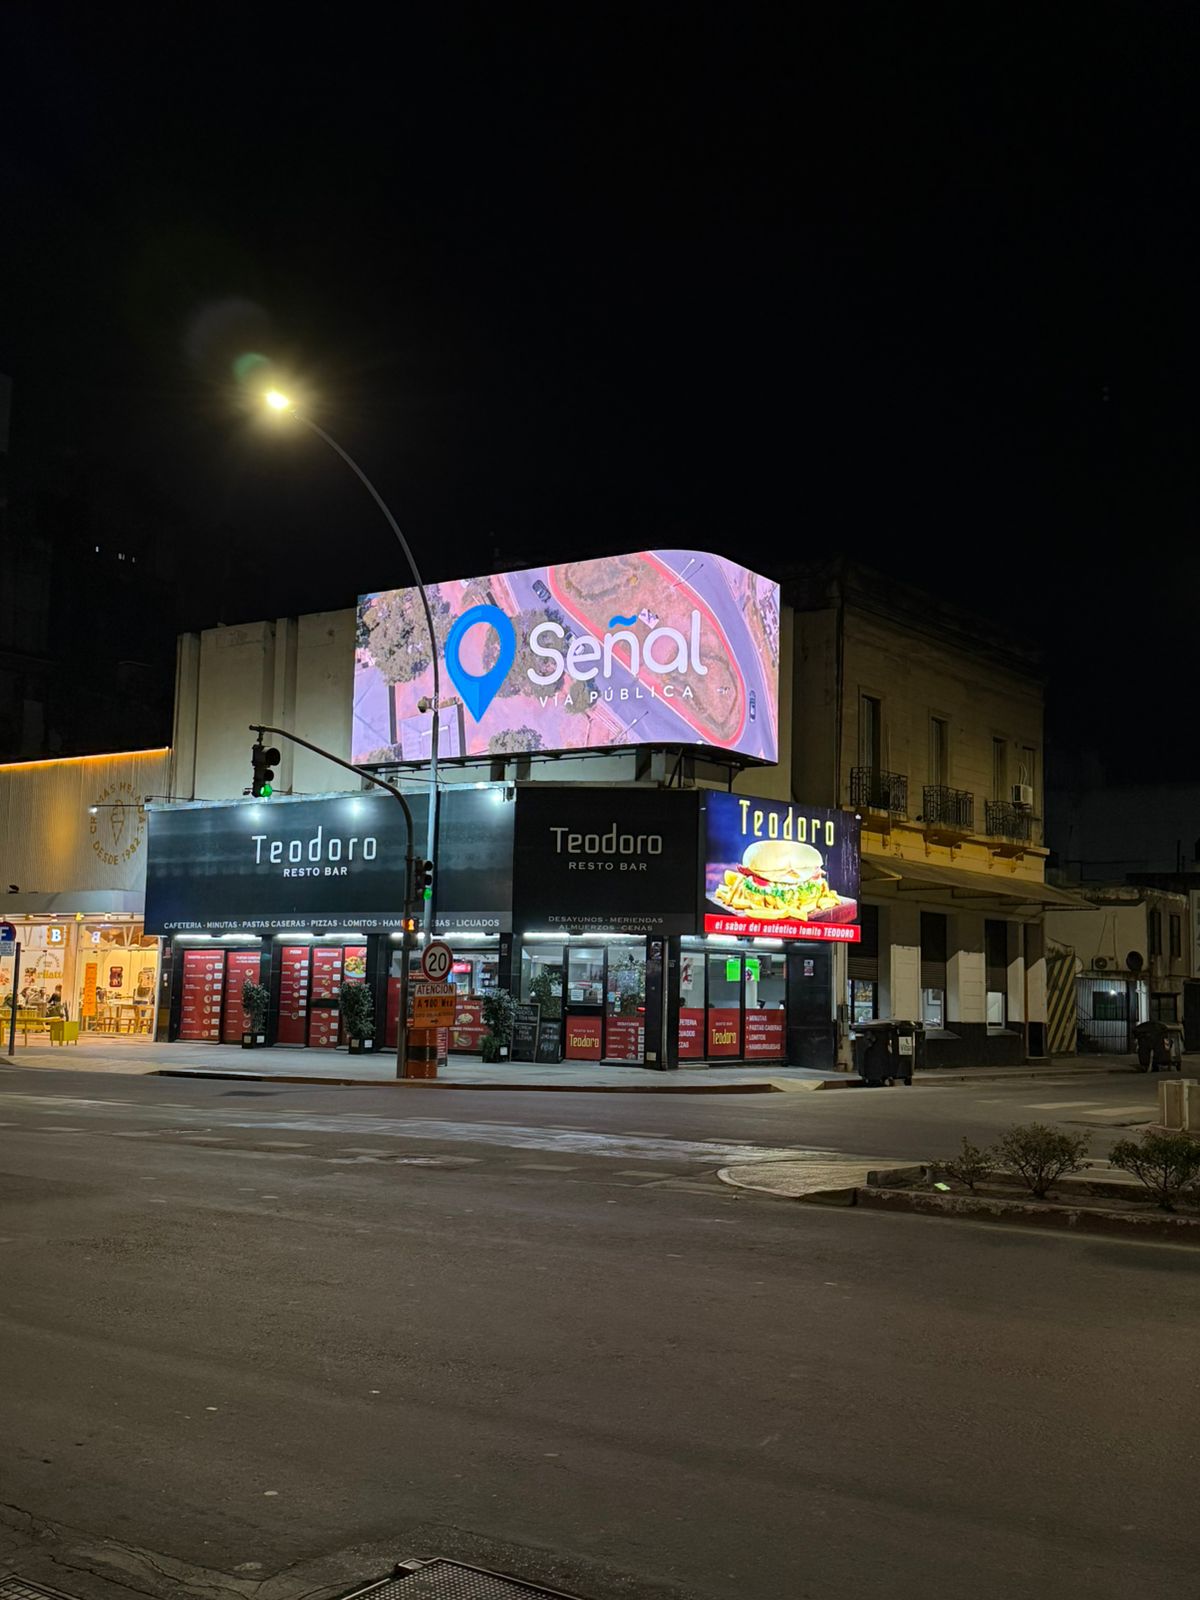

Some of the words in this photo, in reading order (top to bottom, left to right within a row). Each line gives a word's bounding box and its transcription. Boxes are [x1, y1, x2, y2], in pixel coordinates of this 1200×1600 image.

[527, 609, 708, 685] Señal
[590, 685, 693, 704] PÚBLICA
[739, 799, 834, 846] Teodoro
[252, 825, 377, 864] Teodoro
[549, 822, 663, 854] Teodoro
[283, 867, 320, 878] RESTO
[324, 866, 348, 876] BAR
[568, 861, 614, 871] RESTO
[619, 862, 648, 871] BAR
[163, 922, 202, 930] CAFETERIA
[206, 921, 238, 929] MINUTAS
[242, 920, 270, 929] PASTAS
[271, 919, 306, 928] CASERAS
[310, 919, 338, 928] PIZZAS
[342, 919, 378, 927] LOMITOS
[456, 918, 500, 927] LICUADOS
[548, 915, 604, 924] DESAYUNOS
[609, 916, 664, 924] MERIENDAS
[558, 923, 615, 932] ALMUERZOS
[620, 924, 653, 932] CENAS
[51, 928, 62, 943] B
[714, 920, 723, 930] el
[725, 921, 747, 932] sabor
[749, 922, 761, 933] del
[763, 923, 797, 935] auténtico
[799, 926, 822, 937] lomito
[824, 927, 855, 939] TEODORO
[428, 952, 448, 972] 20
[568, 1033, 600, 1048] Teodoro
